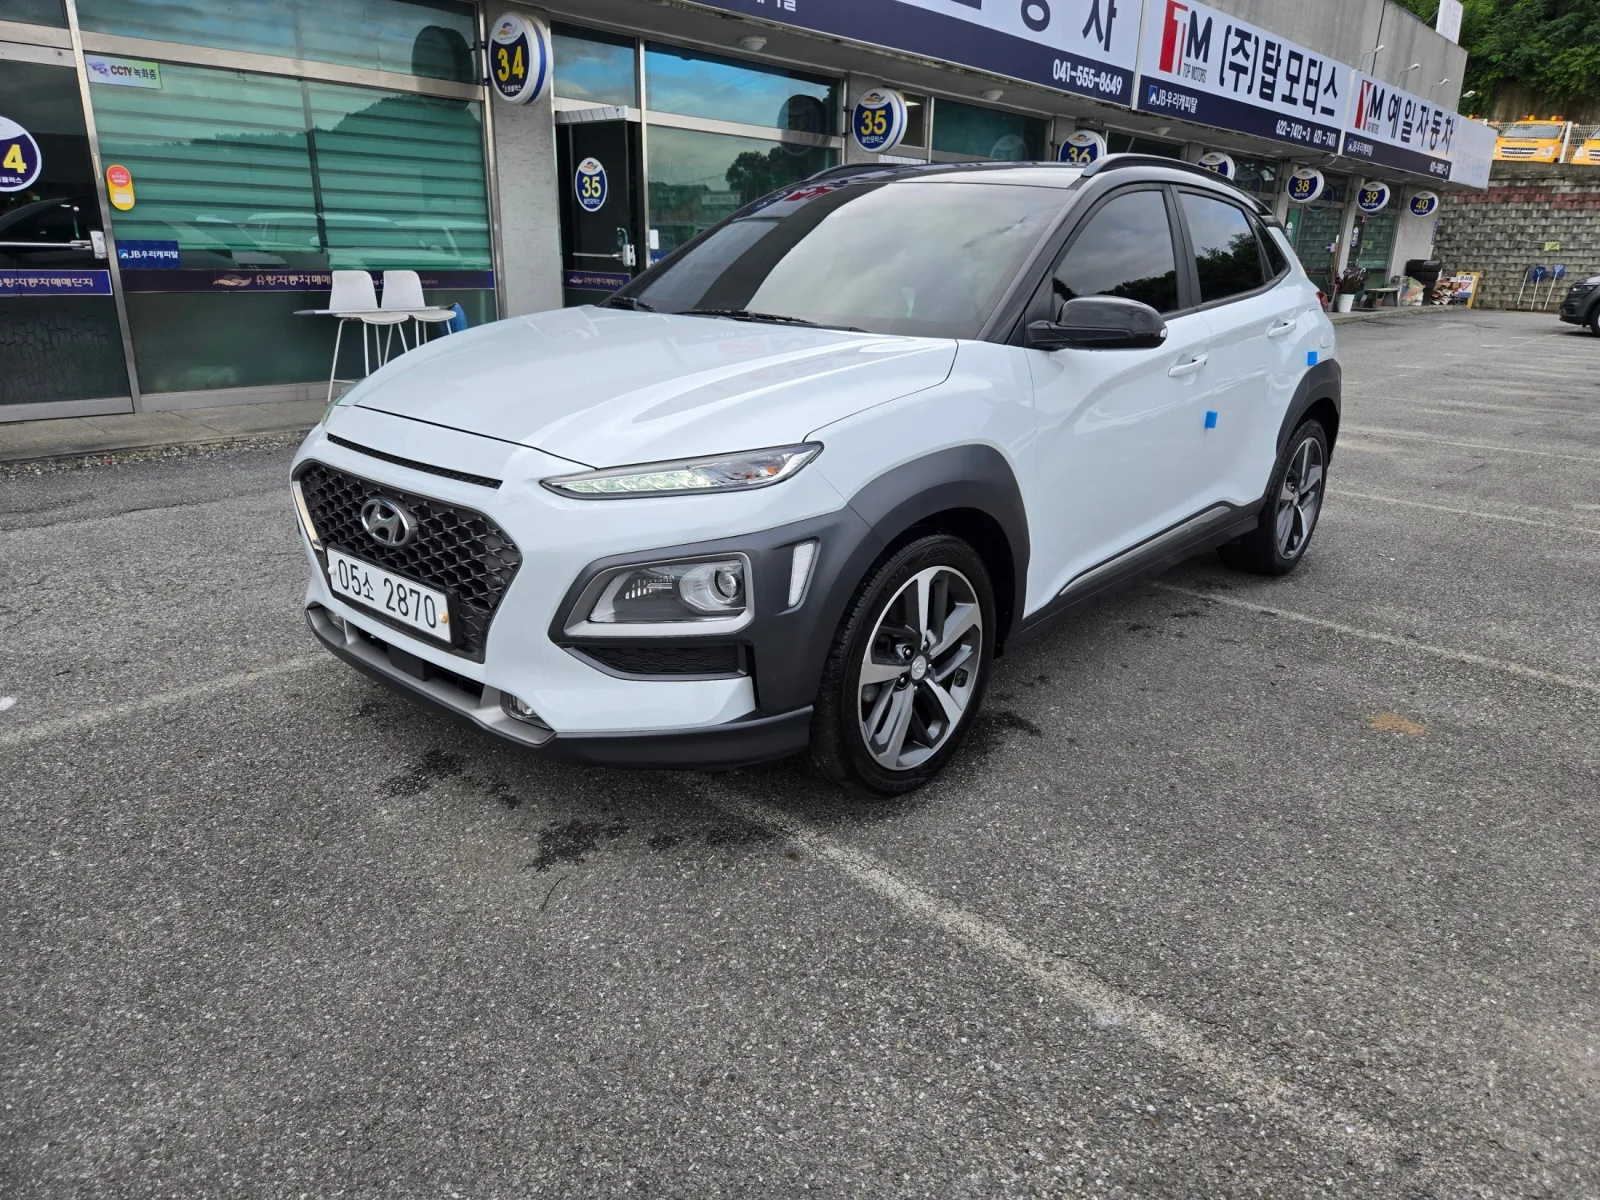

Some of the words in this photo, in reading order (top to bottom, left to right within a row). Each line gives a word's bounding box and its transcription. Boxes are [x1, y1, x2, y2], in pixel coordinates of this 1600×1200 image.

[110, 64, 132, 77] CCTV
[133, 67, 157, 80] 녹화중
[497, 45, 524, 82] 34
[1219, 24, 1339, 117] (주)탑모터스
[1053, 58, 1123, 96] 041-555-8649
[860, 109, 887, 135] 35
[1387, 93, 1455, 156] 예일자동차
[582, 176, 602, 198] 35
[1295, 179, 1310, 193] 38
[1364, 191, 1379, 204] 39
[1415, 199, 1429, 210] 40
[338, 559, 374, 602] 05소
[383, 577, 437, 629] 2870
